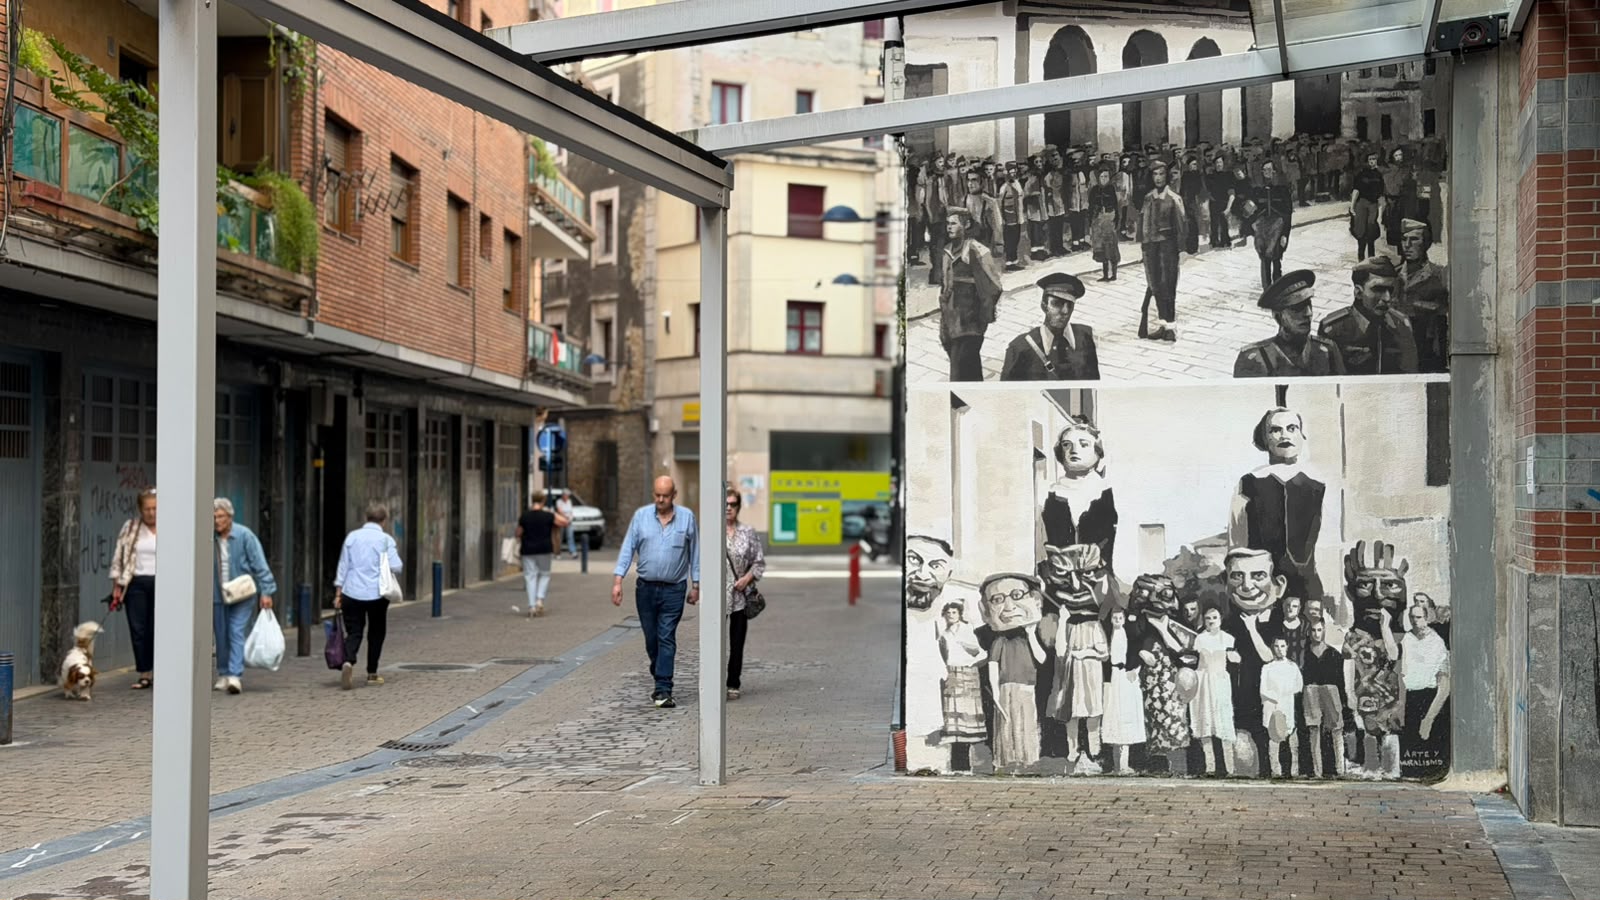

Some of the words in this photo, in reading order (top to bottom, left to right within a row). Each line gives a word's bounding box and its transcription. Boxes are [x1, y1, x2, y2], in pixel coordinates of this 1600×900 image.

[773, 503, 796, 541] L
[1403, 749, 1430, 758] ARTE
[1399, 759, 1443, 767] MURALISMO
